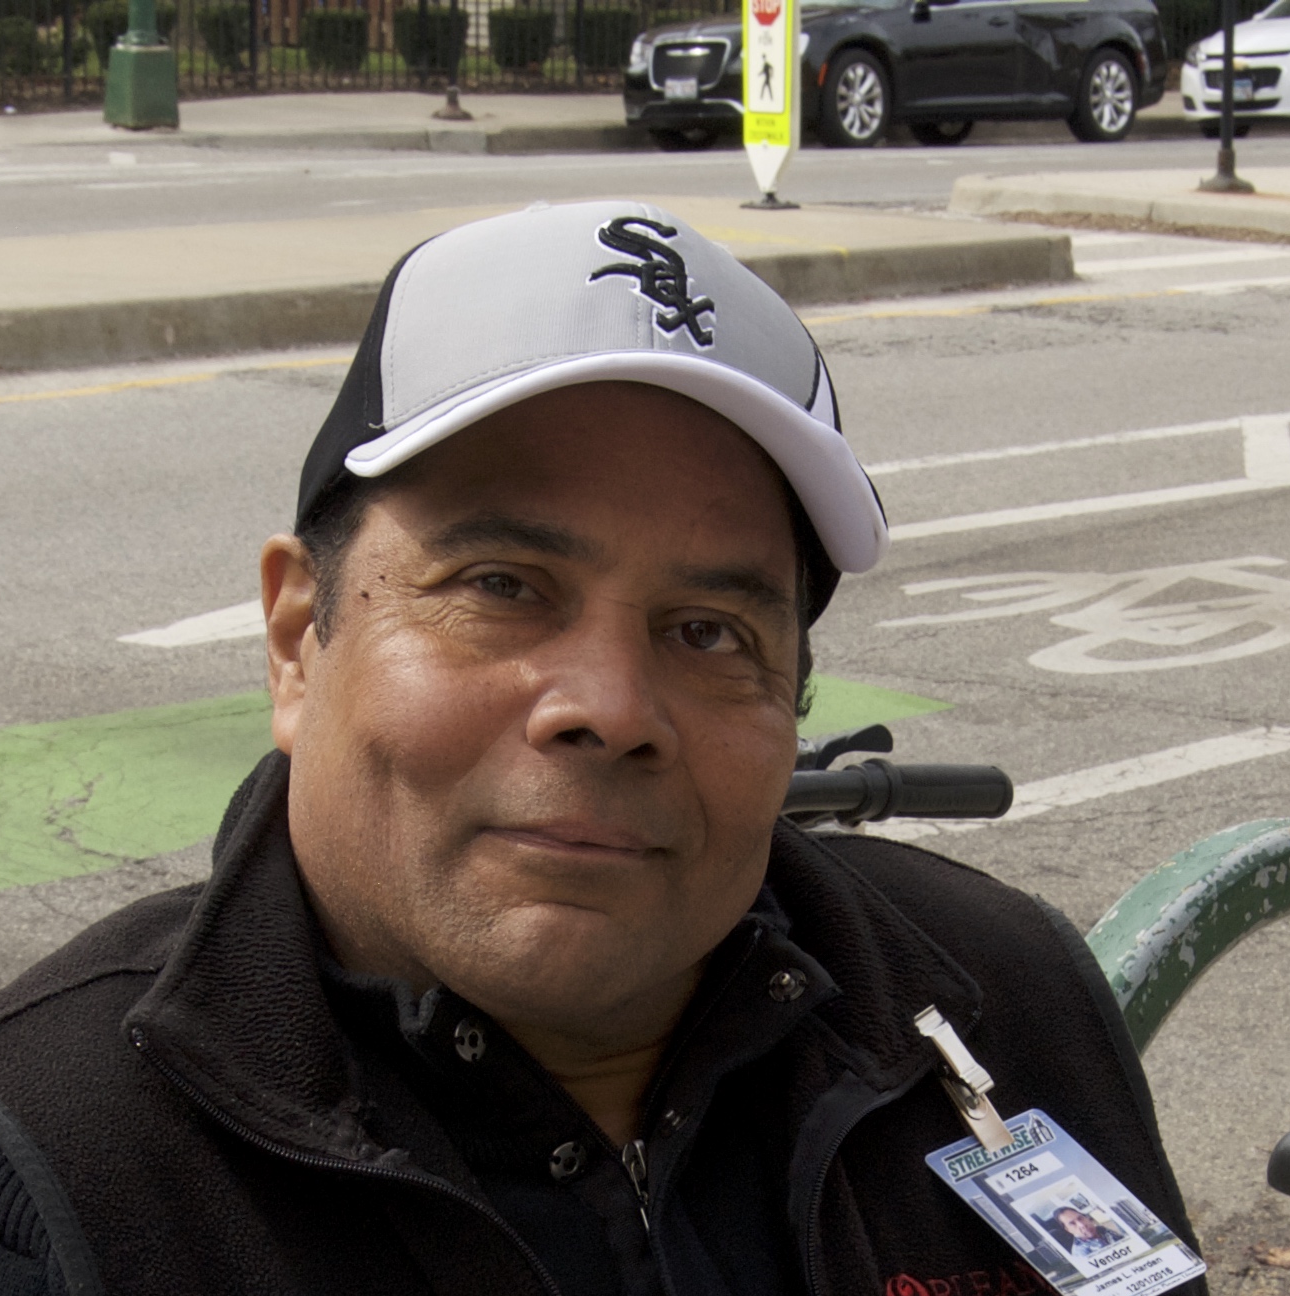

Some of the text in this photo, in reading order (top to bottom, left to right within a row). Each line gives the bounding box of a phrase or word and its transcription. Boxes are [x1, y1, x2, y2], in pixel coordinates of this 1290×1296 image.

[948, 1130, 1032, 1178] STREEWISE
[1005, 1162, 1039, 1183] 1264
[1088, 1245, 1133, 1269] Vendor
[1094, 1275, 1123, 1293] James
